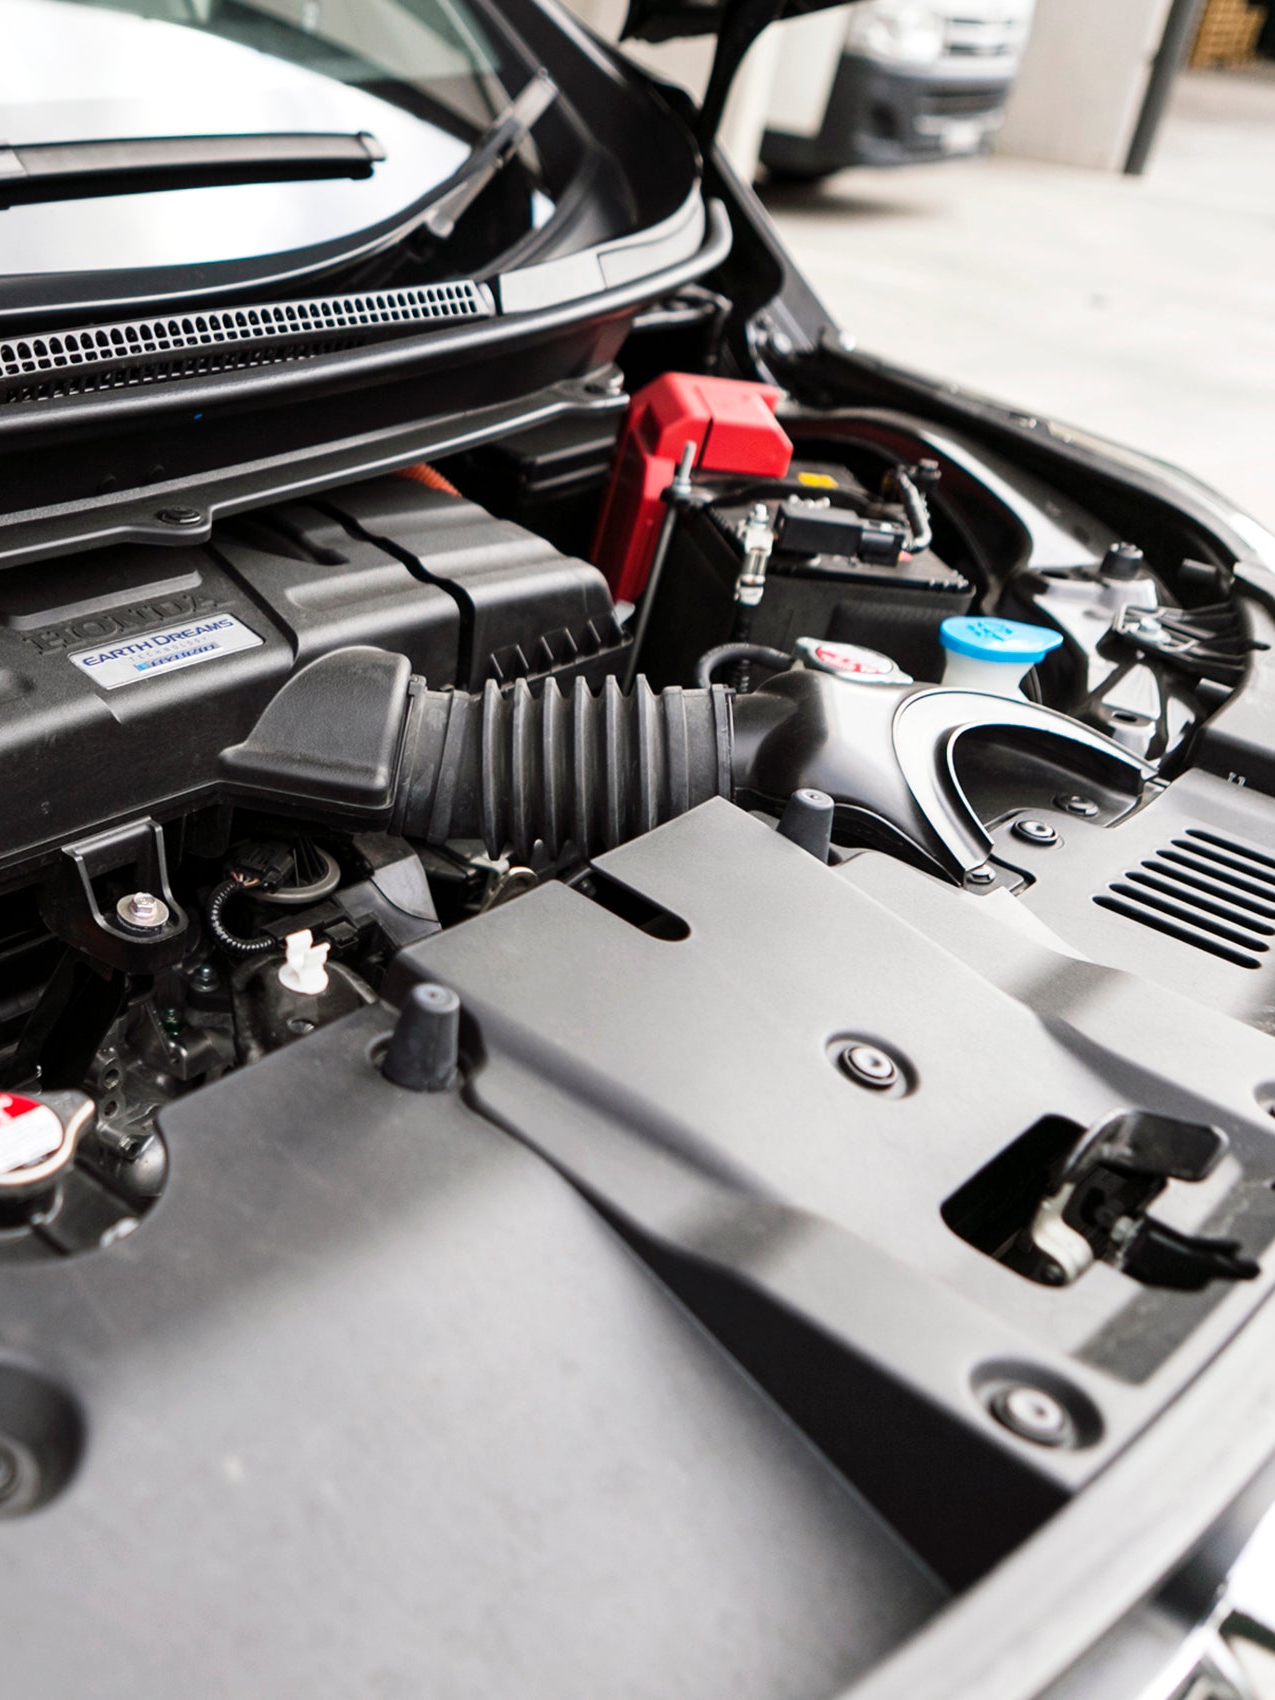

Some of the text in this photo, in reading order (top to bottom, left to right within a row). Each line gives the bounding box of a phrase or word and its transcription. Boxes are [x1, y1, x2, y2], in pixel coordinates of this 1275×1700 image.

[24, 592, 234, 655] HONDA
[82, 618, 234, 666] EARTH DREAMS
